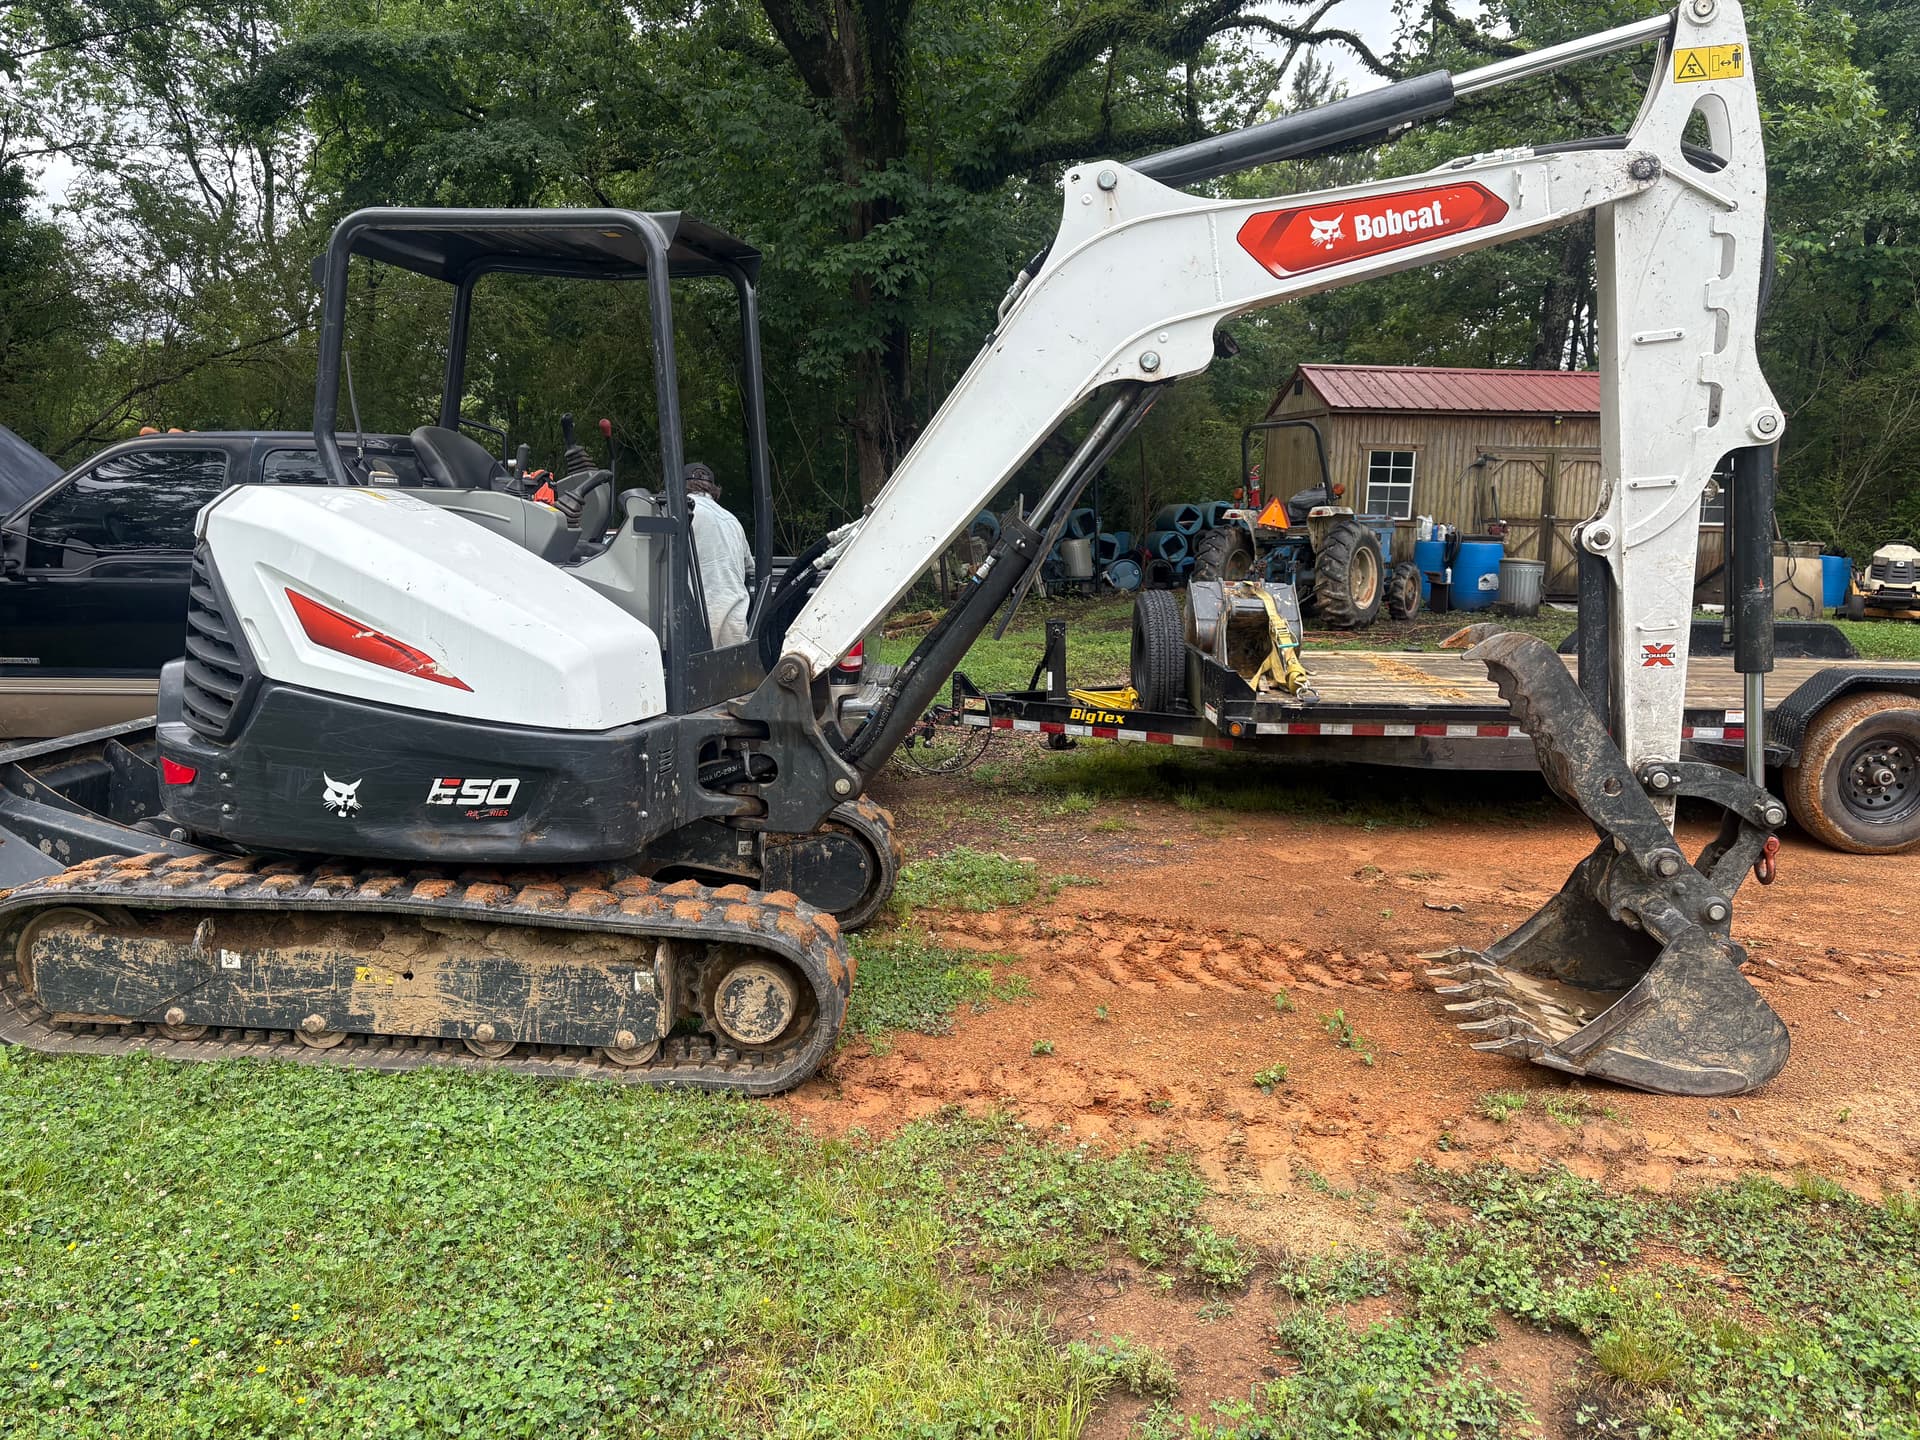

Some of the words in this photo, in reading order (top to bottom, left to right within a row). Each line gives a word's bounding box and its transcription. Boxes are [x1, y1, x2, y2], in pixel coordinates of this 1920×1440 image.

[1354, 200, 1444, 242] Bobcat
[1069, 708, 1125, 725] BigTex
[426, 778, 520, 805] E50
